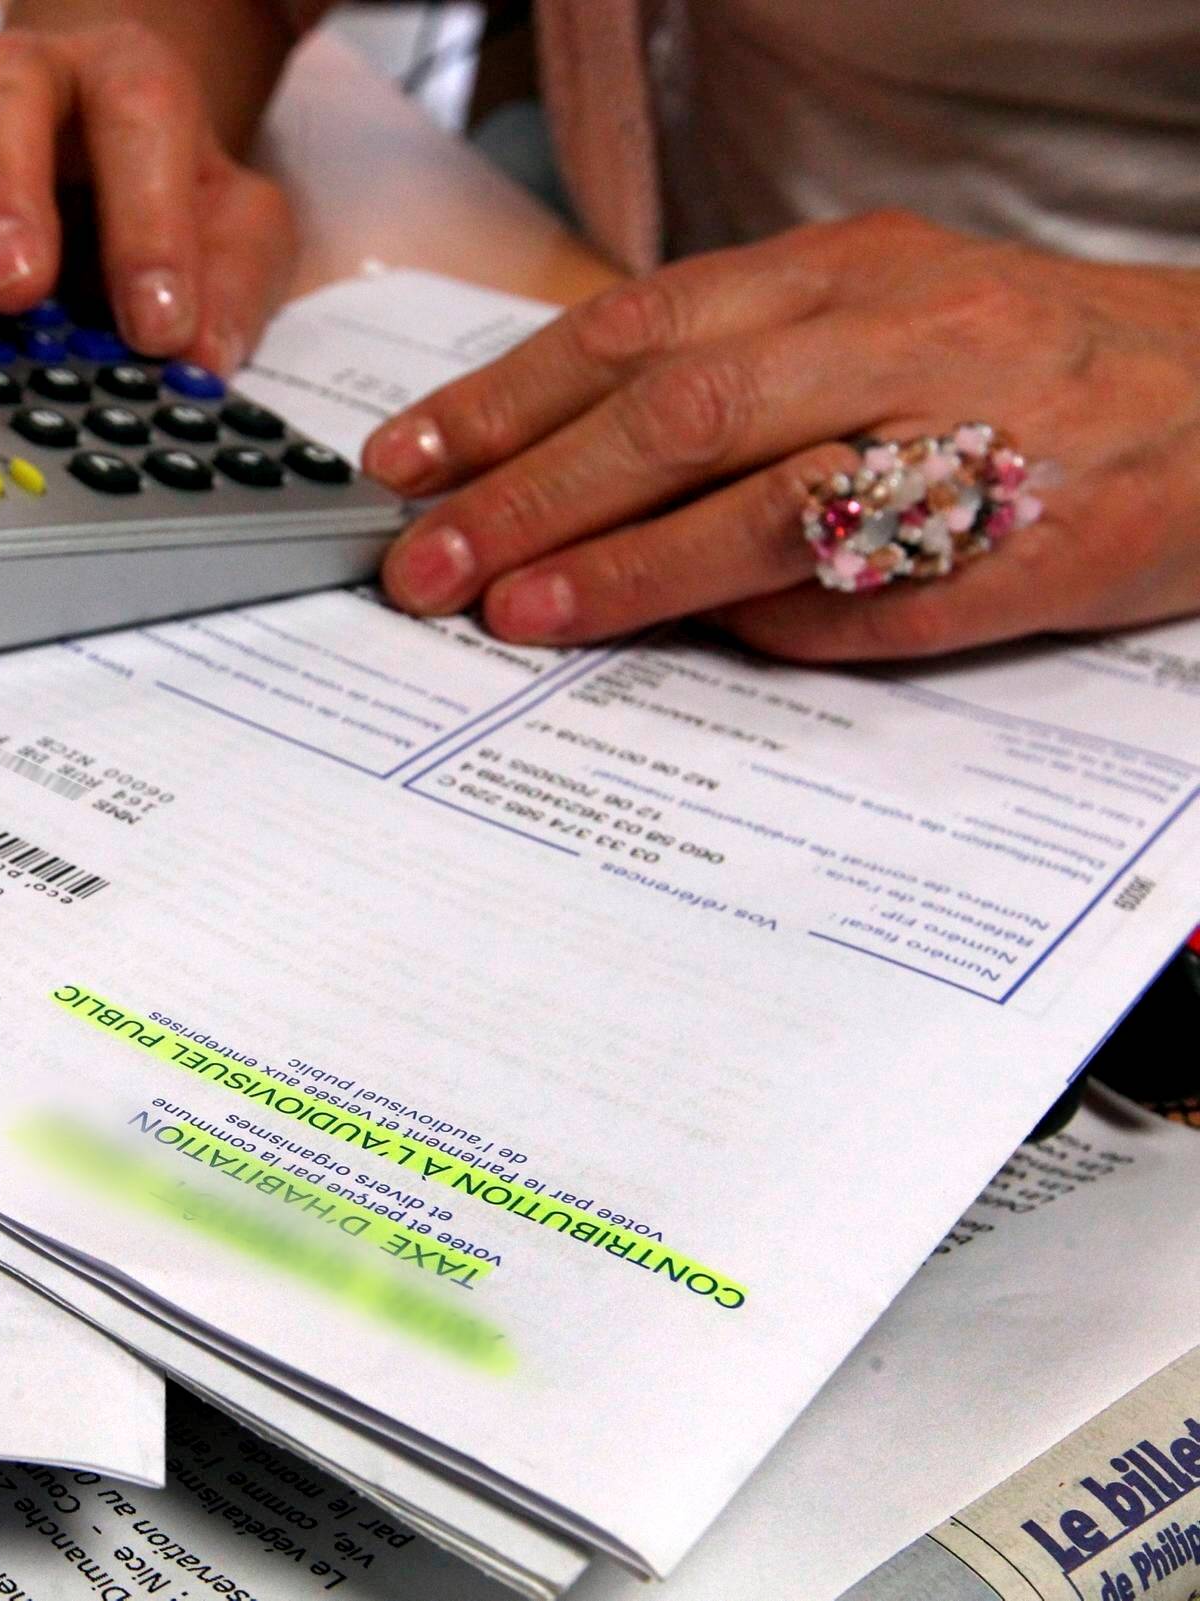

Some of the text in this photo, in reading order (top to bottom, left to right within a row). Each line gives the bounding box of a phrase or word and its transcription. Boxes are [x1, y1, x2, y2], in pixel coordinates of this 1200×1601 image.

[600, 861, 778, 932] Vos références
[53, 984, 746, 1310] CONTRIBUTION À L'AUDIOVISUEL PUBLIC
[148, 1011, 663, 1243] votée par le Parlement et versée aux entreprises
[287, 1058, 528, 1164] de l'audiovisuel public
[128, 1110, 479, 1291] TAXE D'HABITATION
[151, 1097, 502, 1267] votée et perçue par la commune
[225, 1113, 454, 1222] et divers organismes
[97, 1489, 137, 1517] au
[166, 1457, 348, 1591] Le végétalisme
[327, 1497, 359, 1521] le
[357, 1519, 416, 1549] par
[1019, 1508, 1110, 1574] Le
[13, 1497, 132, 1601] Dimanche
[113, 1545, 172, 1594] Nice
[333, 1531, 375, 1570] vie,
[1100, 1569, 1138, 1601] de
